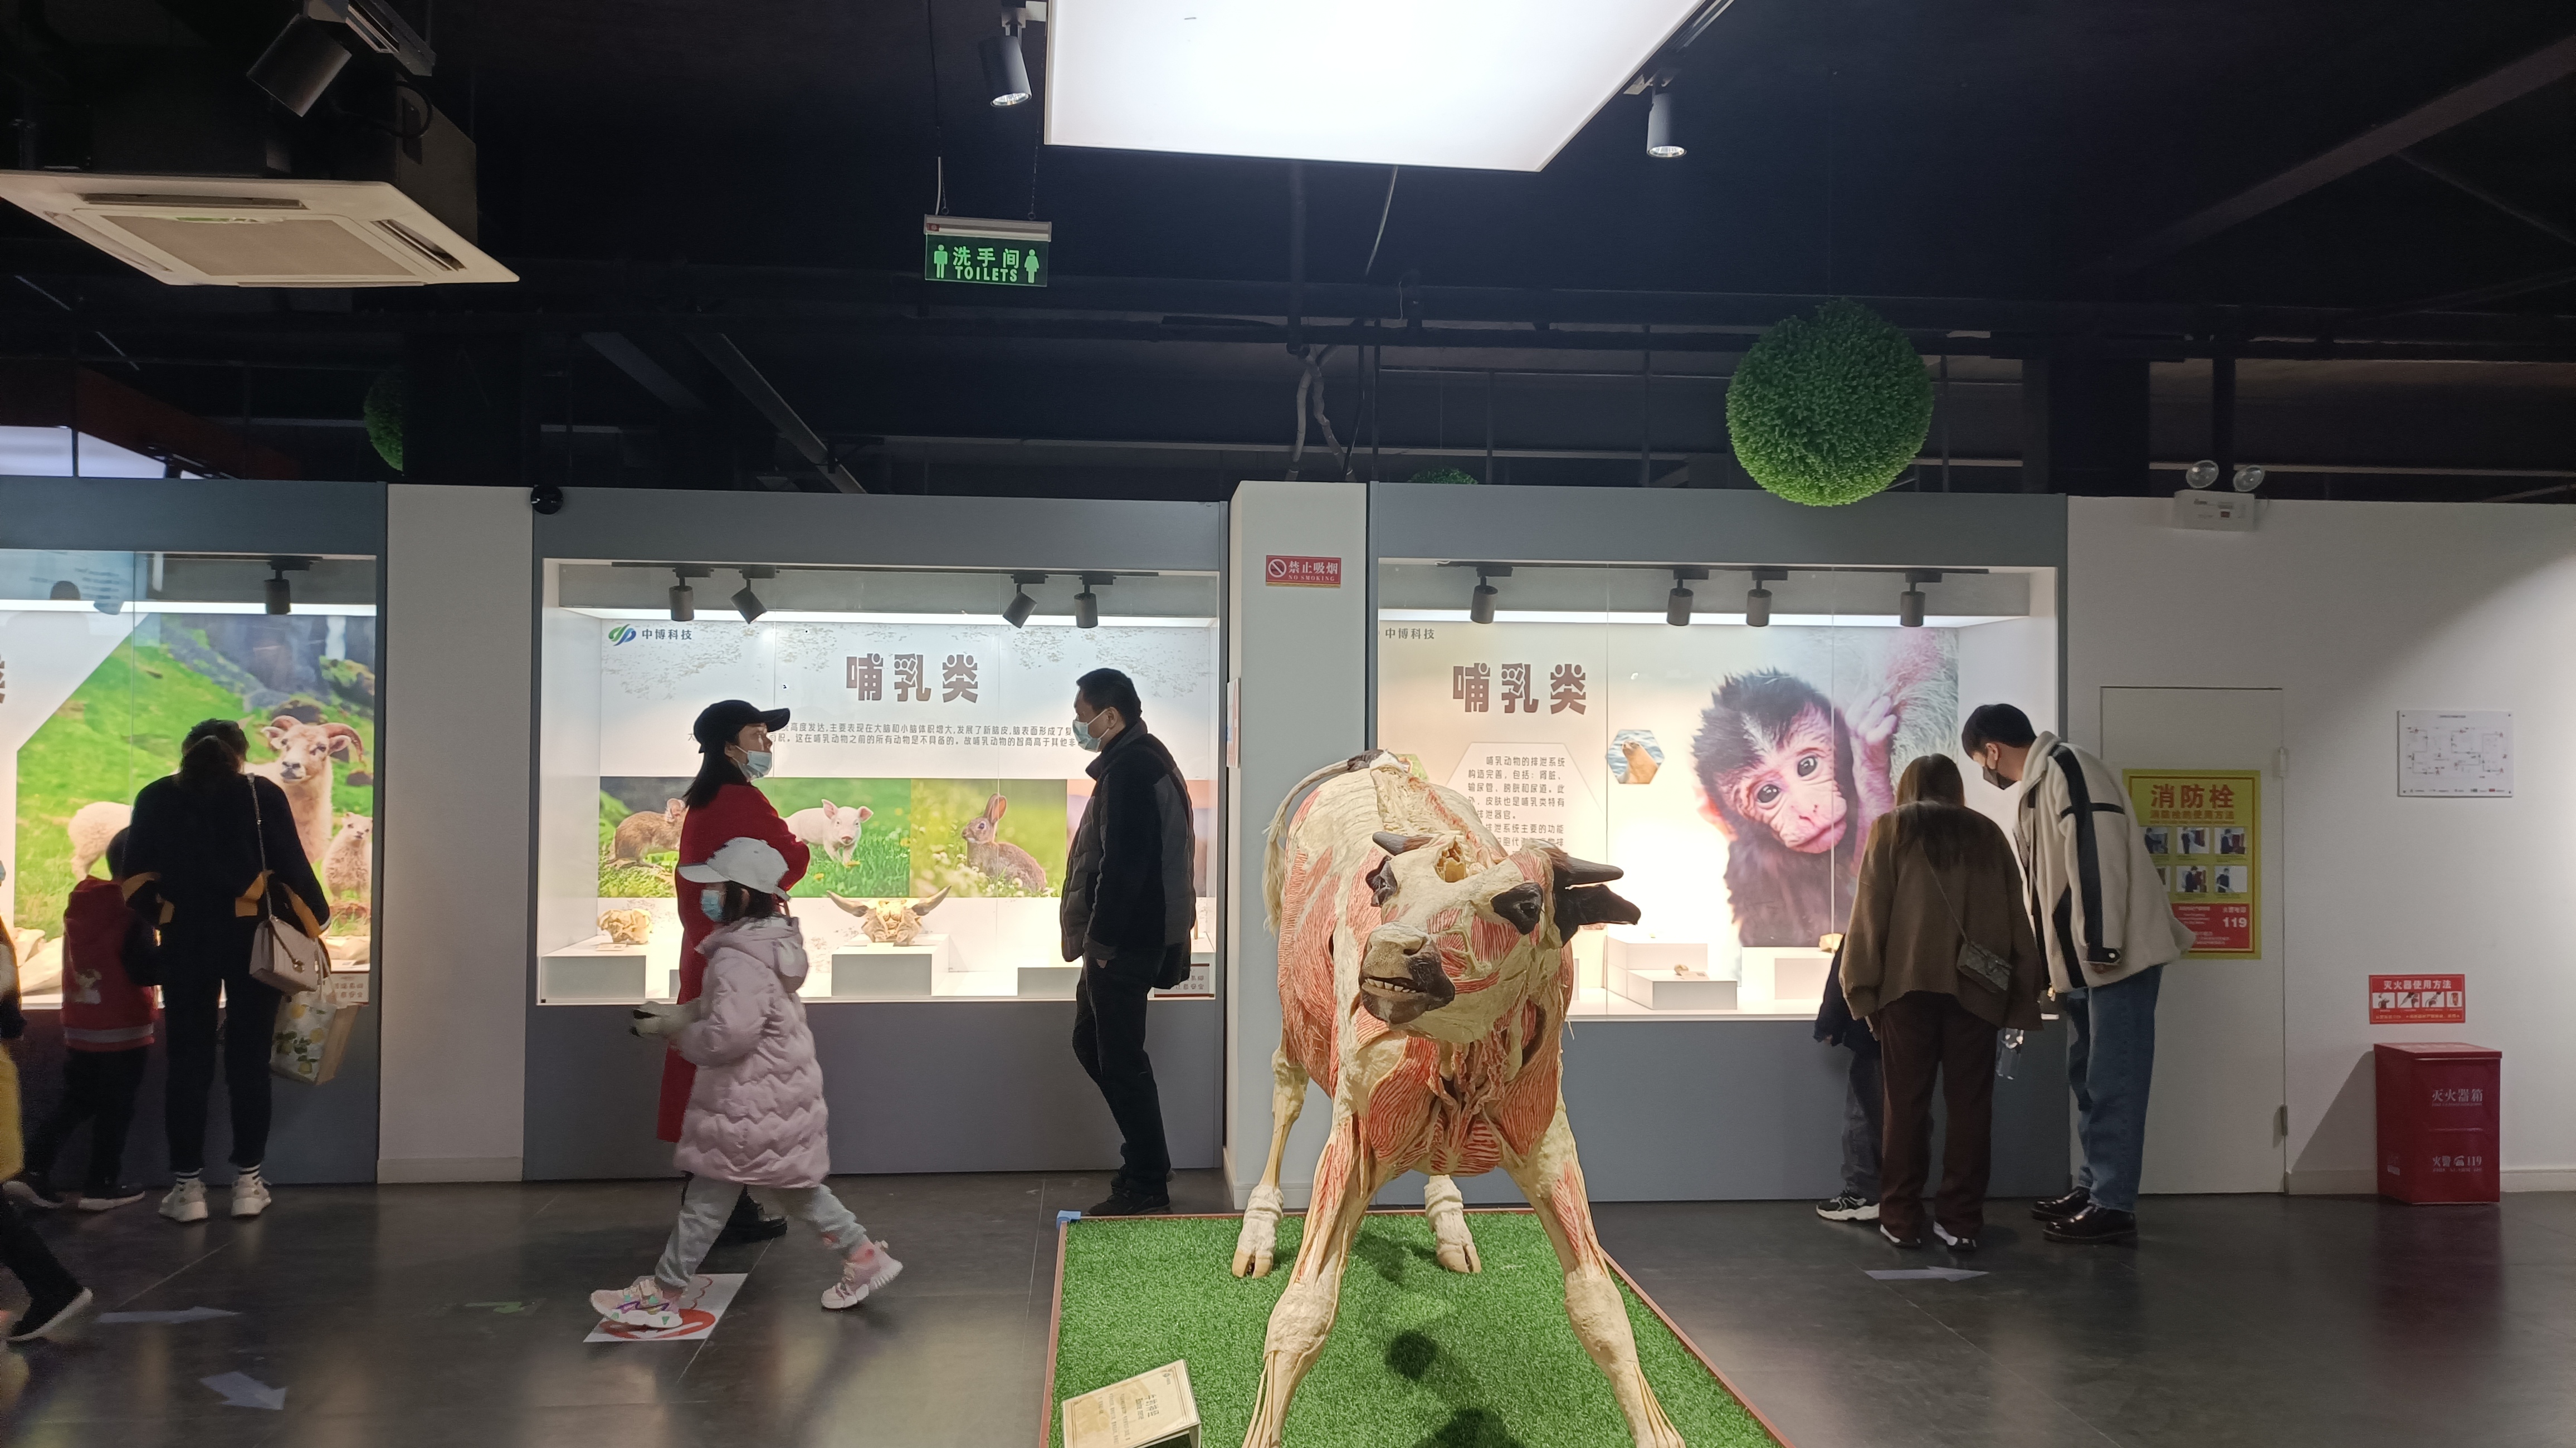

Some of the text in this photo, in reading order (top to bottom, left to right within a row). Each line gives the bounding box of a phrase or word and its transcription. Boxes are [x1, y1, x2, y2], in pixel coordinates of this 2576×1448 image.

[953, 246, 1019, 268] 洗手间
[955, 266, 1018, 282] TOILETS
[1289, 561, 1338, 574] 禁止吸烟
[641, 628, 692, 640] 中博科技
[1385, 628, 1435, 639] 中博科技
[846, 652, 979, 703] 哺乳类
[1453, 662, 1587, 715] 哺乳类
[1486, 756, 1565, 767] 哺乳动物的排泄系统
[2150, 783, 2235, 809] 消防栓
[2223, 917, 2247, 928] 119
[2383, 980, 2452, 991] 灭火器使用方法
[2432, 1088, 2484, 1102] 灭火器箱
